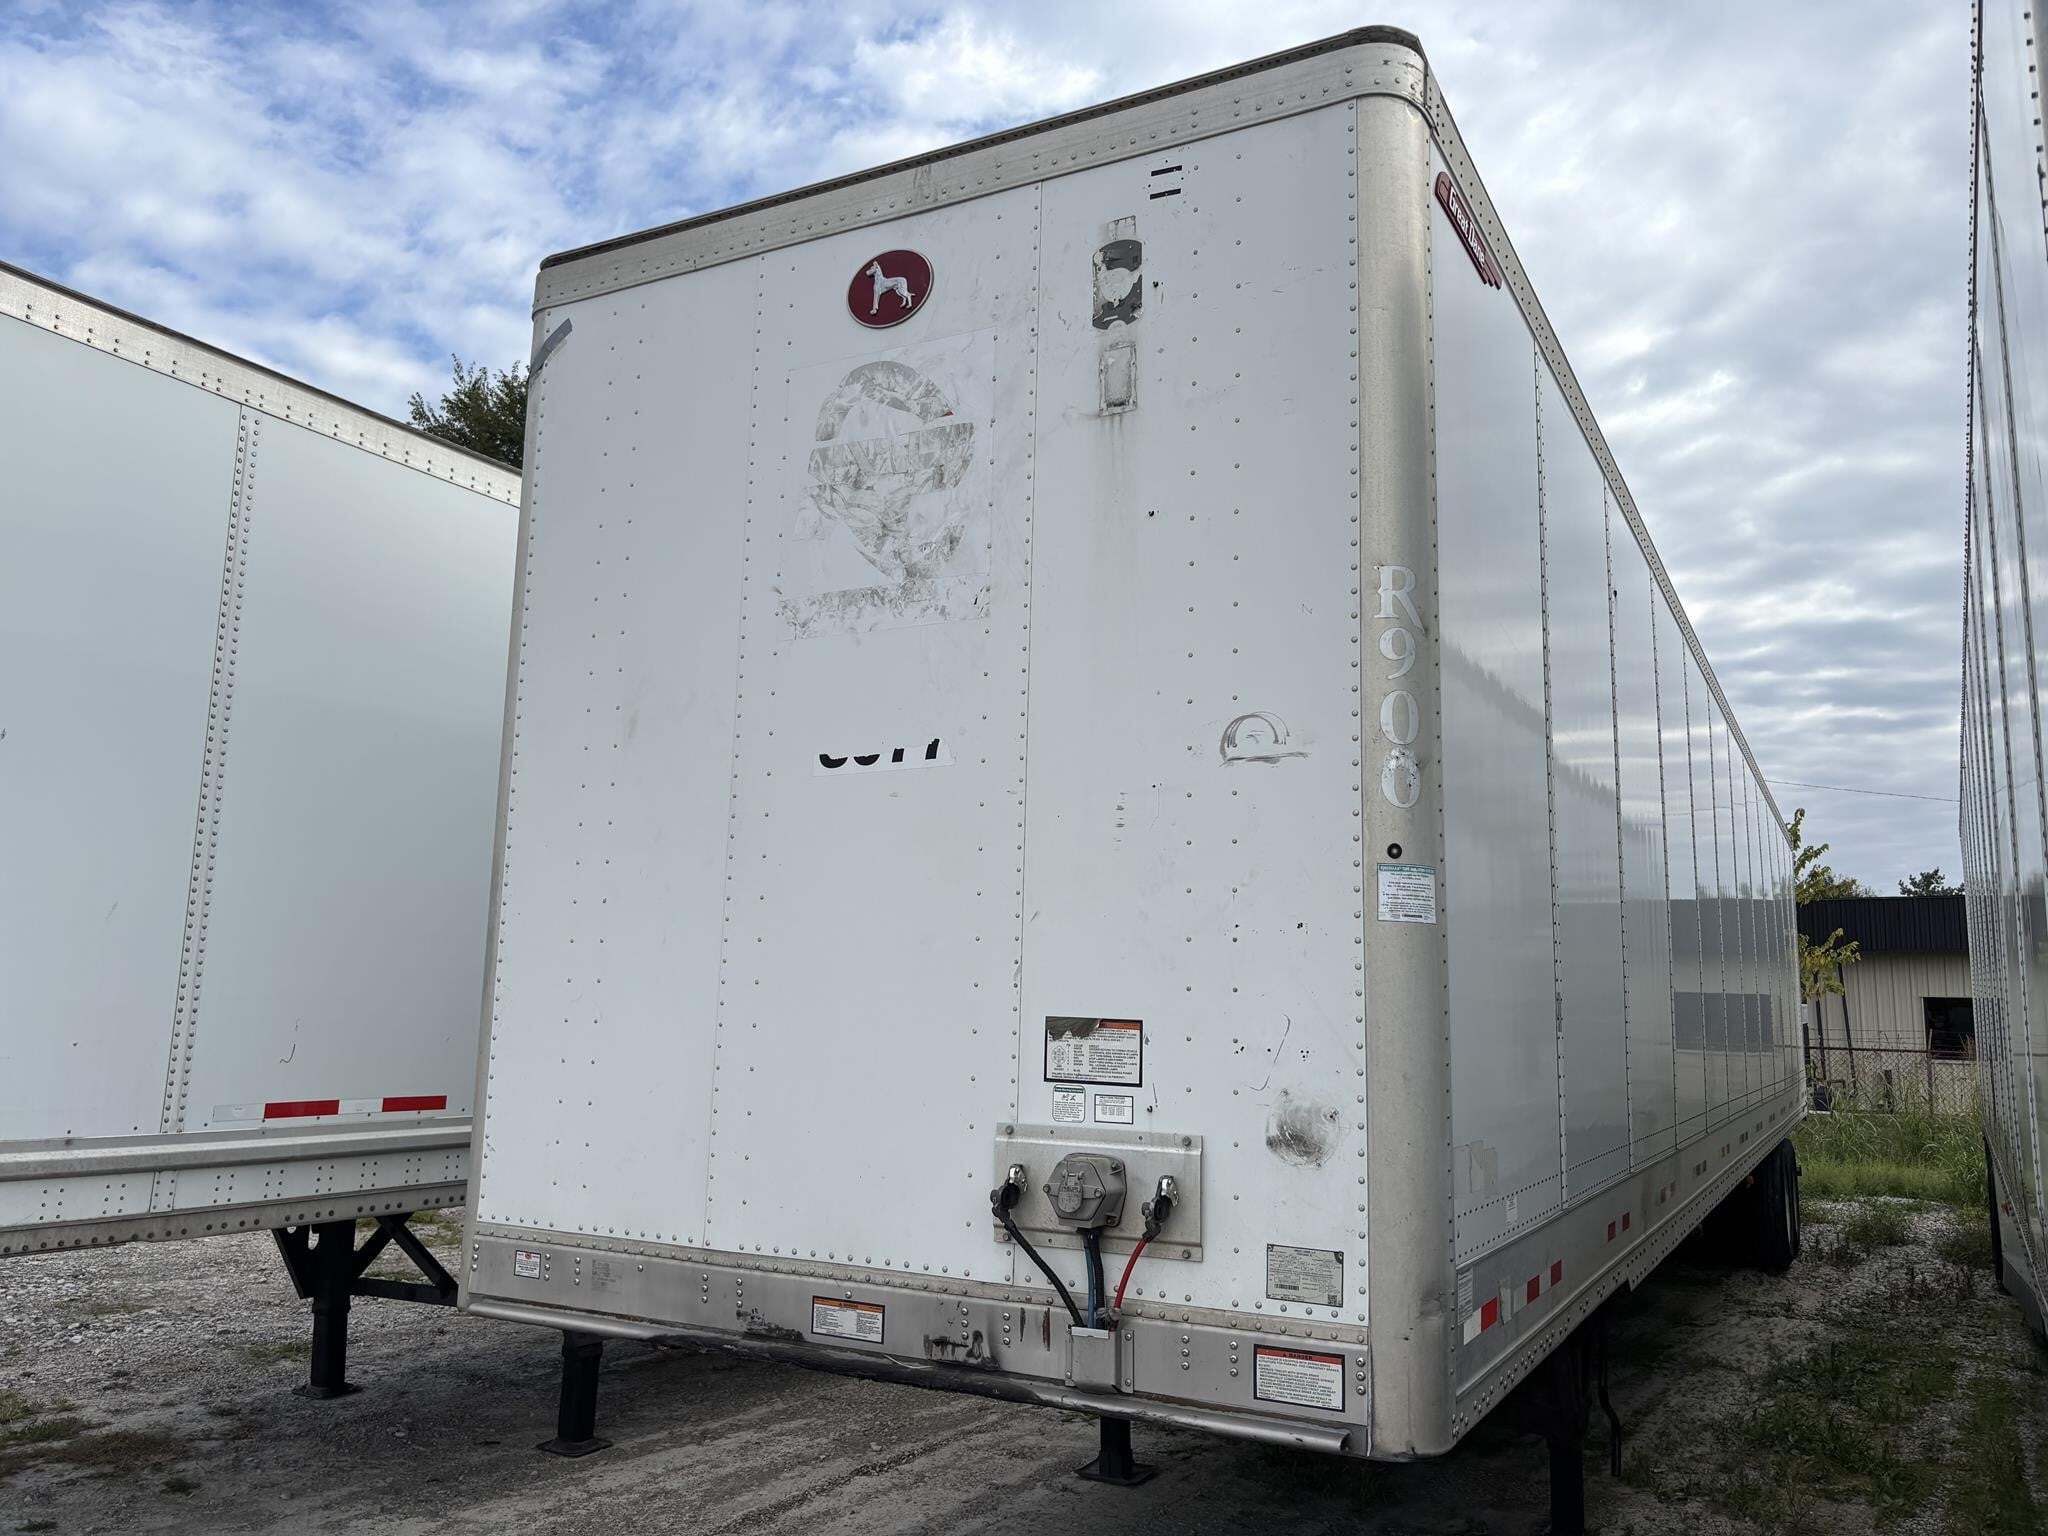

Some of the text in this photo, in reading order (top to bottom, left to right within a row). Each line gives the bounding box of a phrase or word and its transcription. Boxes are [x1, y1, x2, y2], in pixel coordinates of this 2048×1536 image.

[1449, 186, 1486, 268] Great Dane
[1374, 564, 1426, 809] R900
